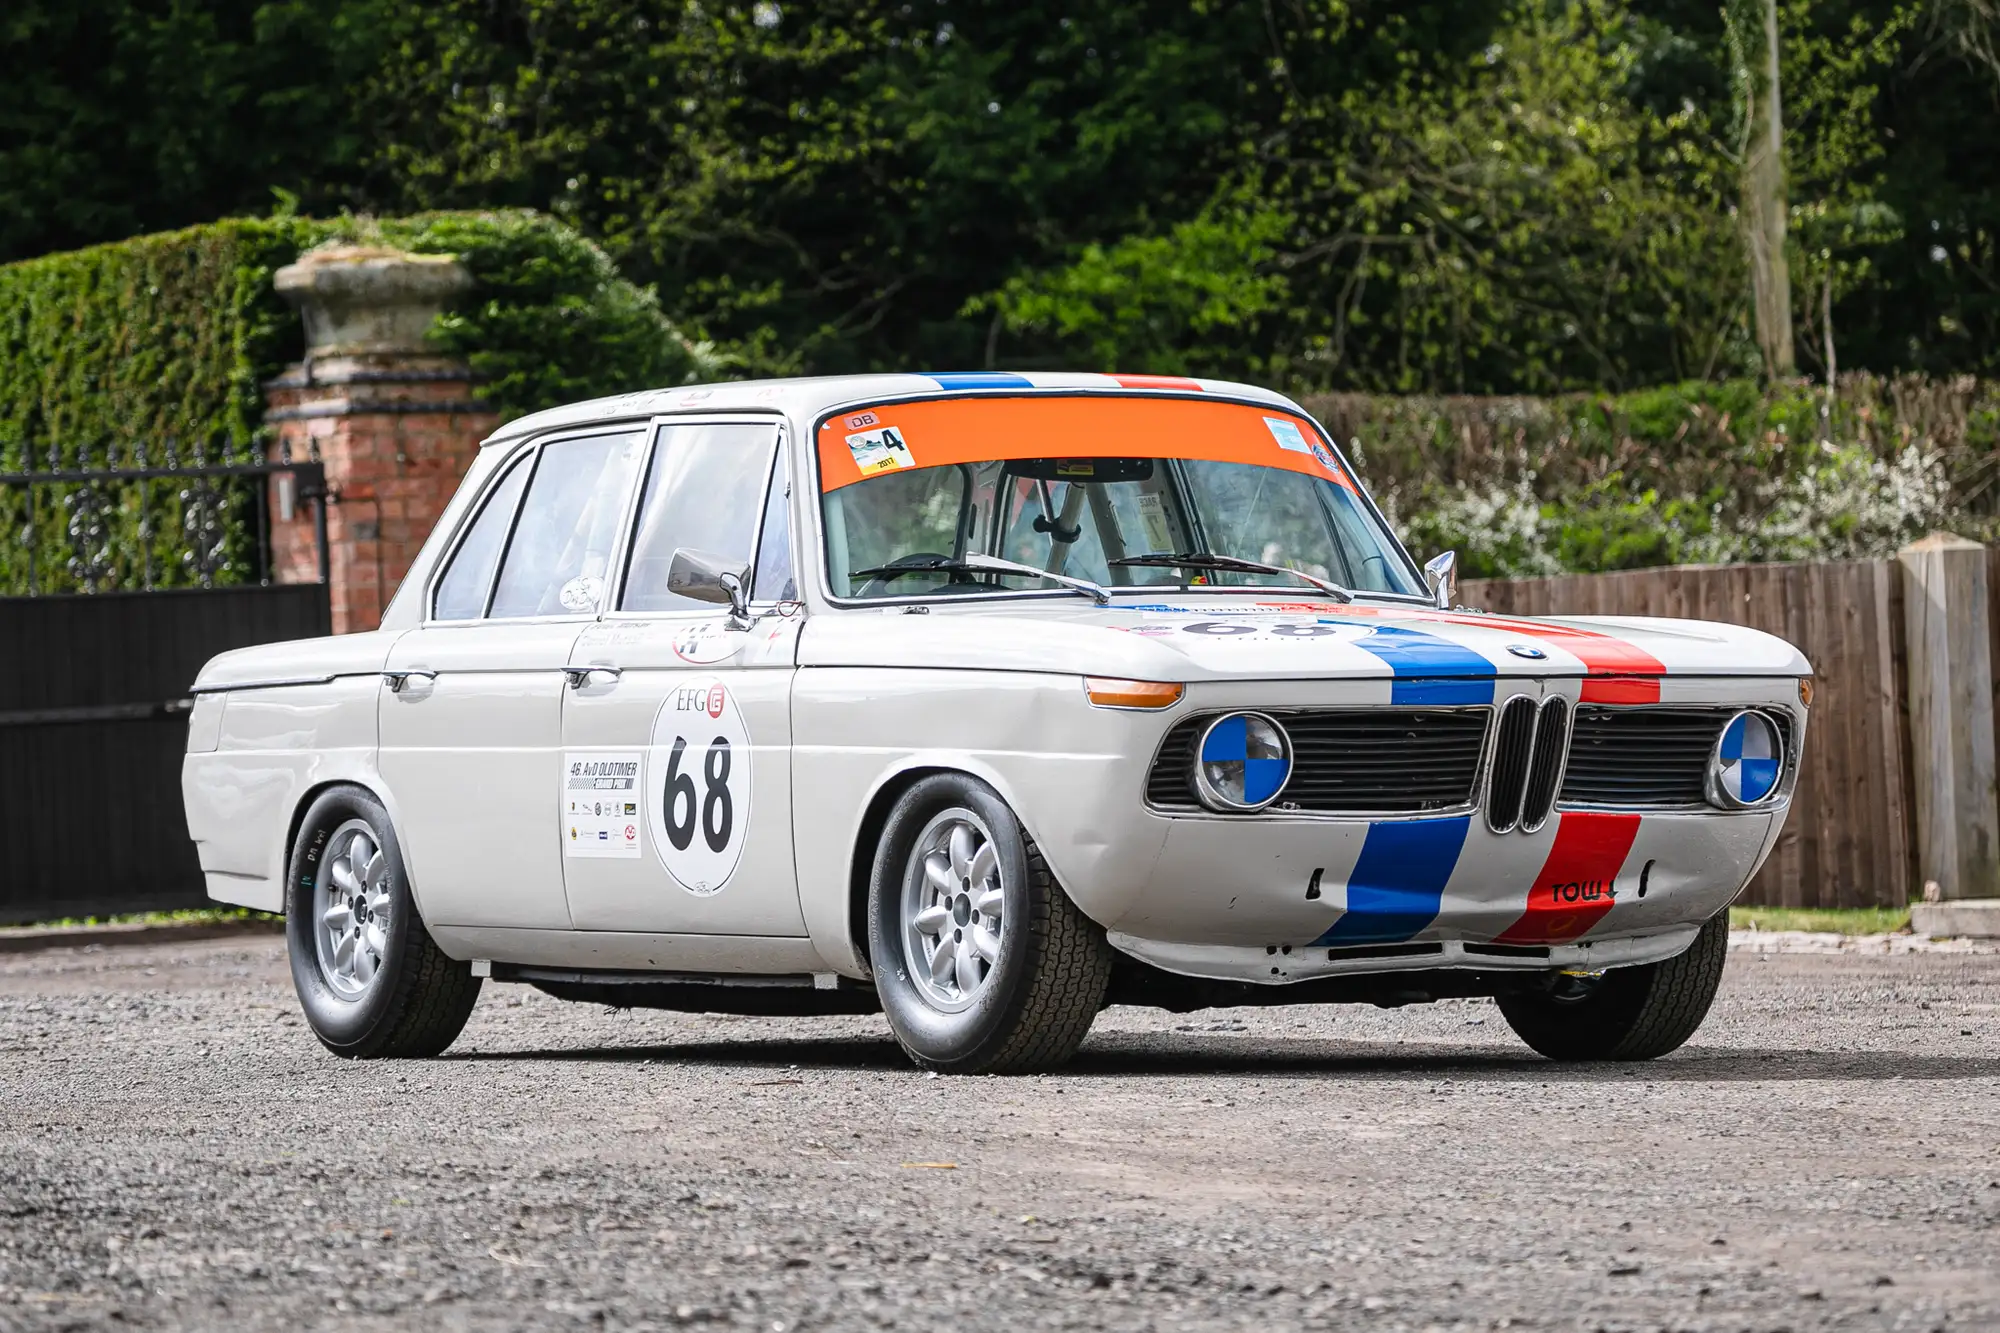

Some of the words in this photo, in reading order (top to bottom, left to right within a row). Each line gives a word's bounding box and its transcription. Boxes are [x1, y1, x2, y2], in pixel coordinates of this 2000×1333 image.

[881, 429, 905, 452] 4
[877, 457, 895, 469] 2017
[1181, 622, 1337, 637] 68
[676, 688, 706, 712] EFG
[582, 762, 598, 777] AvD
[598, 762, 638, 777] OLDTIMER
[663, 735, 733, 853] 68
[1551, 880, 1602, 902] TOW
